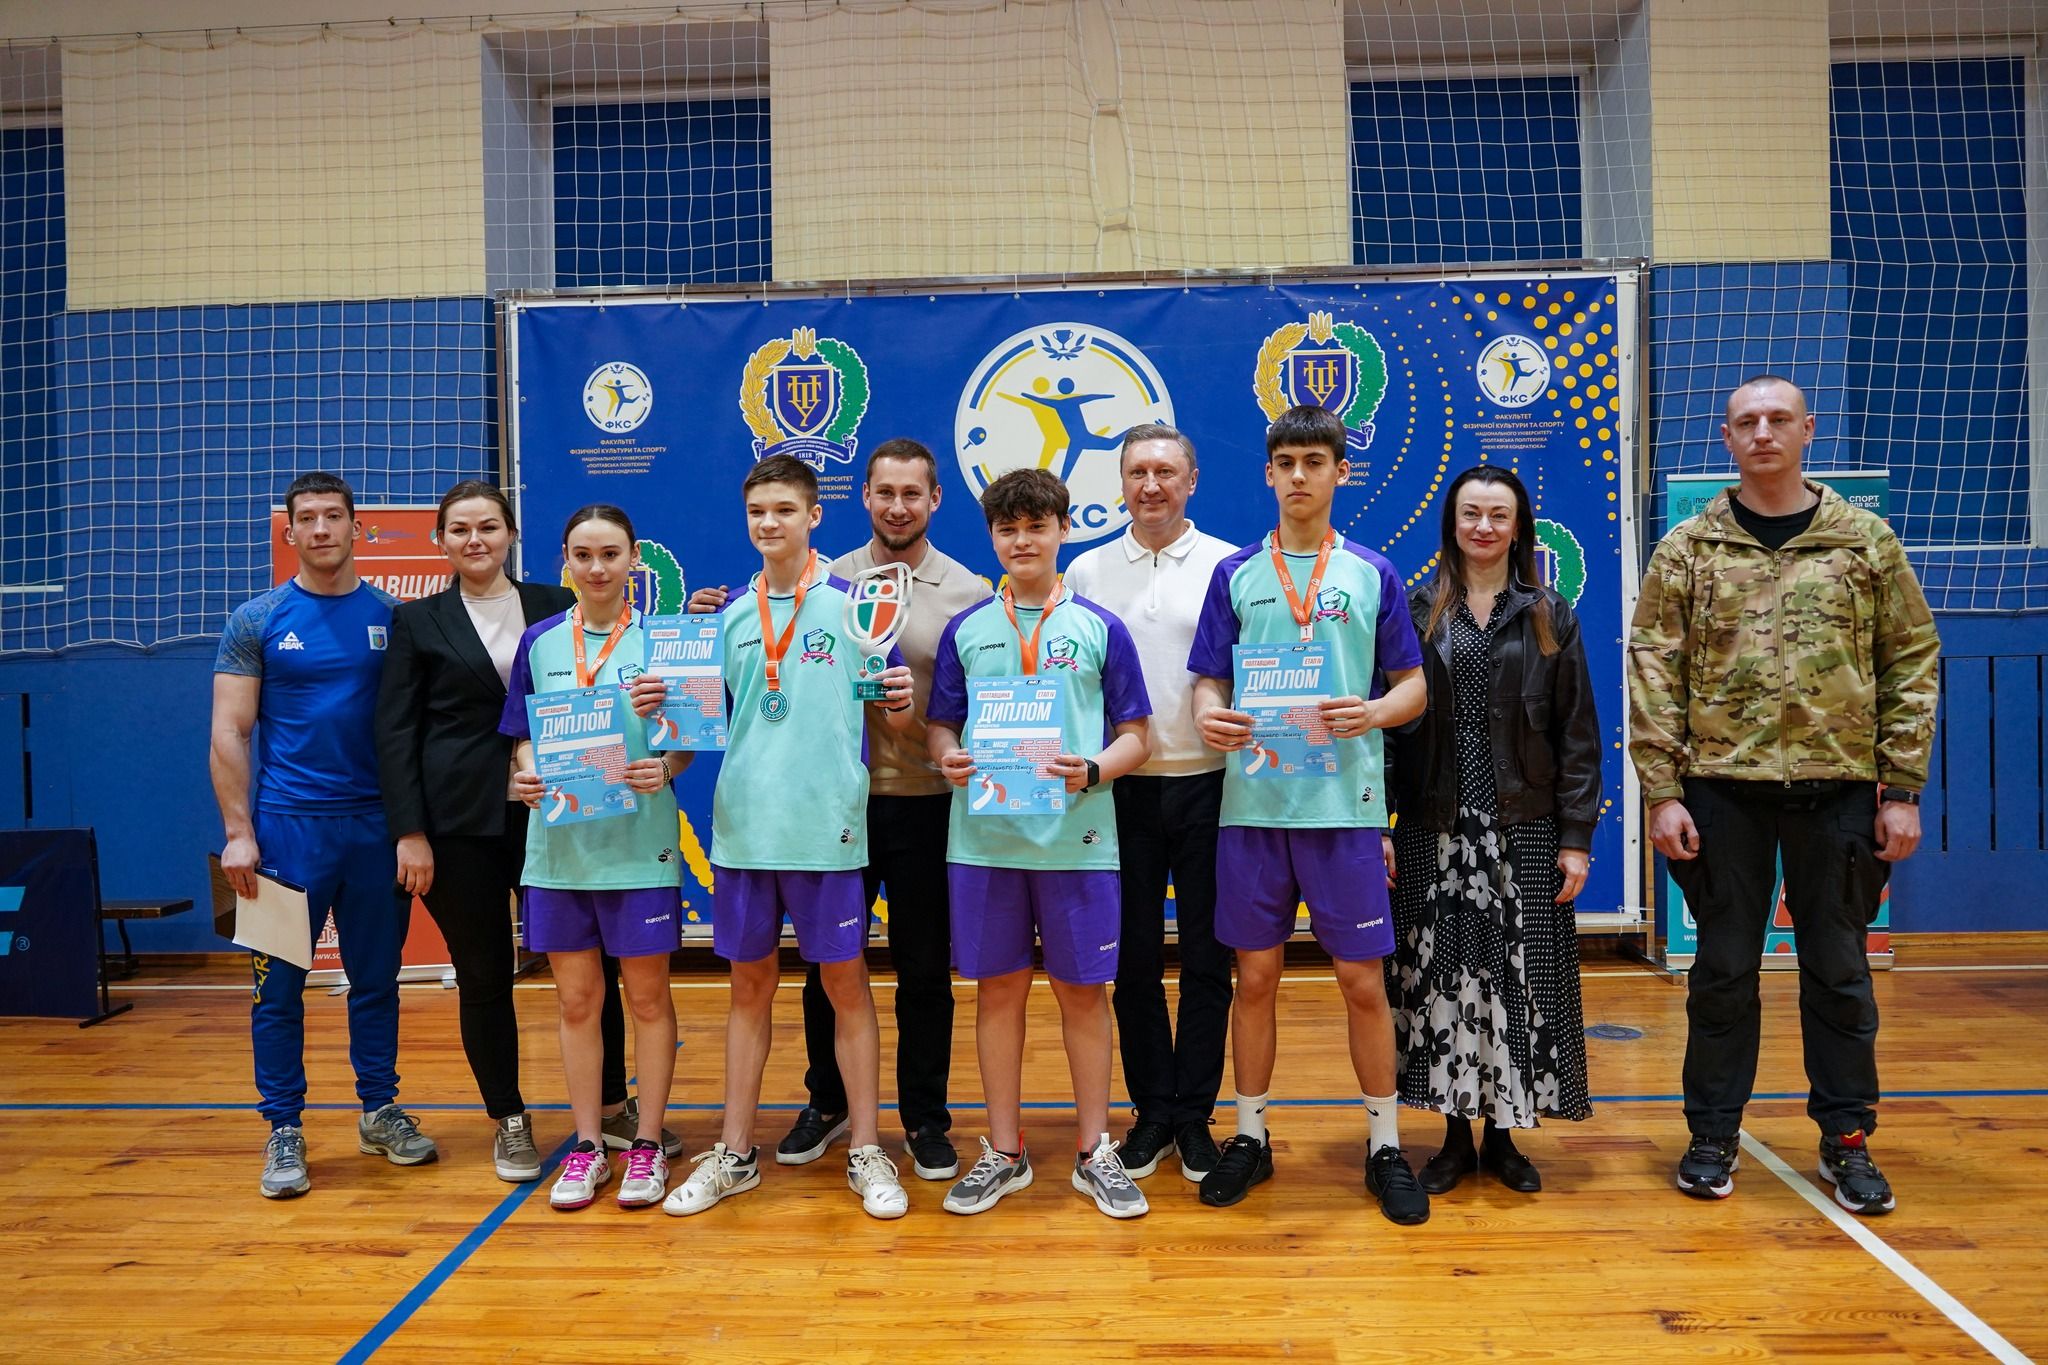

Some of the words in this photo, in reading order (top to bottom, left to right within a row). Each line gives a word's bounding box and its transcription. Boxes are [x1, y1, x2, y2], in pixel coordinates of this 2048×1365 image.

[1500, 395, 1527, 403] ФКС
[605, 420, 631, 428] ФКС
[1849, 495, 1880, 503] СПОРТ
[1070, 504, 1108, 529] КС
[279, 642, 304, 650] PEAK
[651, 640, 714, 662] ДИПЛОМ
[1244, 669, 1320, 692] ДИПЛОМ
[977, 702, 1052, 724] ДИПЛОМ
[540, 710, 612, 739] ДИПЛОМ
